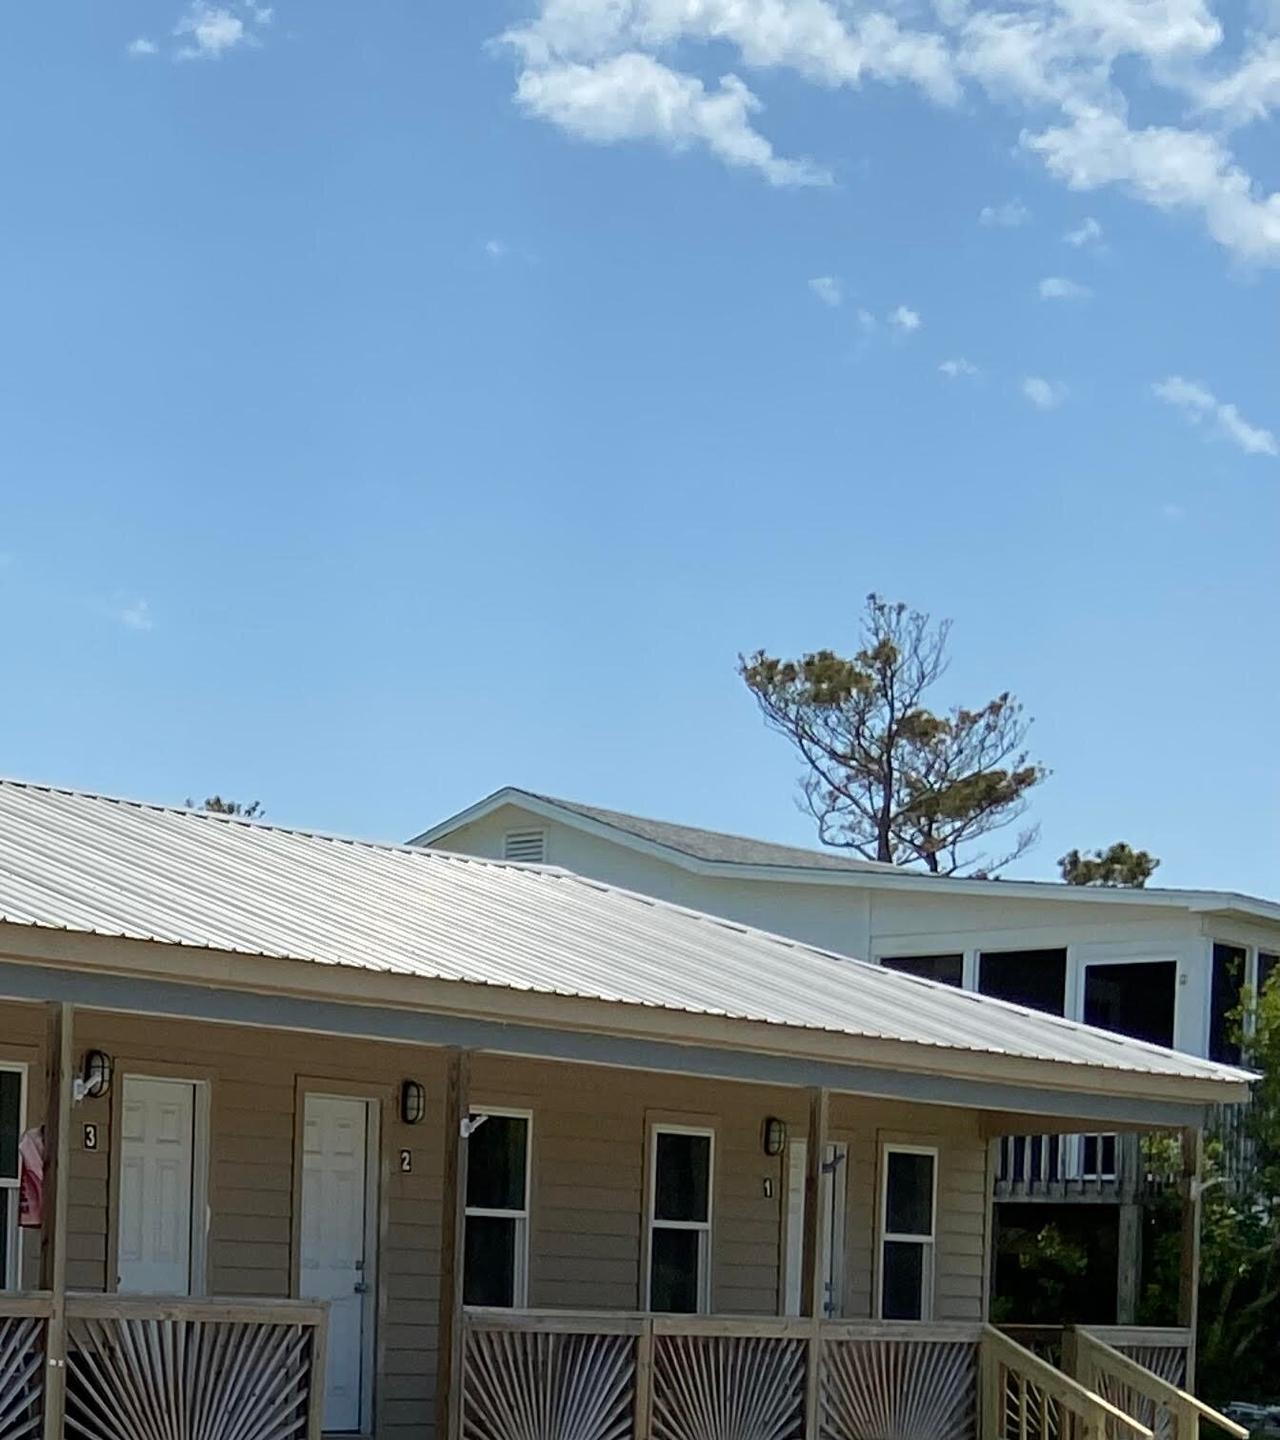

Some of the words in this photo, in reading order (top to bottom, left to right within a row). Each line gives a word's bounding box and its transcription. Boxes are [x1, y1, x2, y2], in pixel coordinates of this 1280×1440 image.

[86, 1126, 95, 1147] 3
[401, 1151, 410, 1170] 2
[764, 1179, 771, 1197] 1
